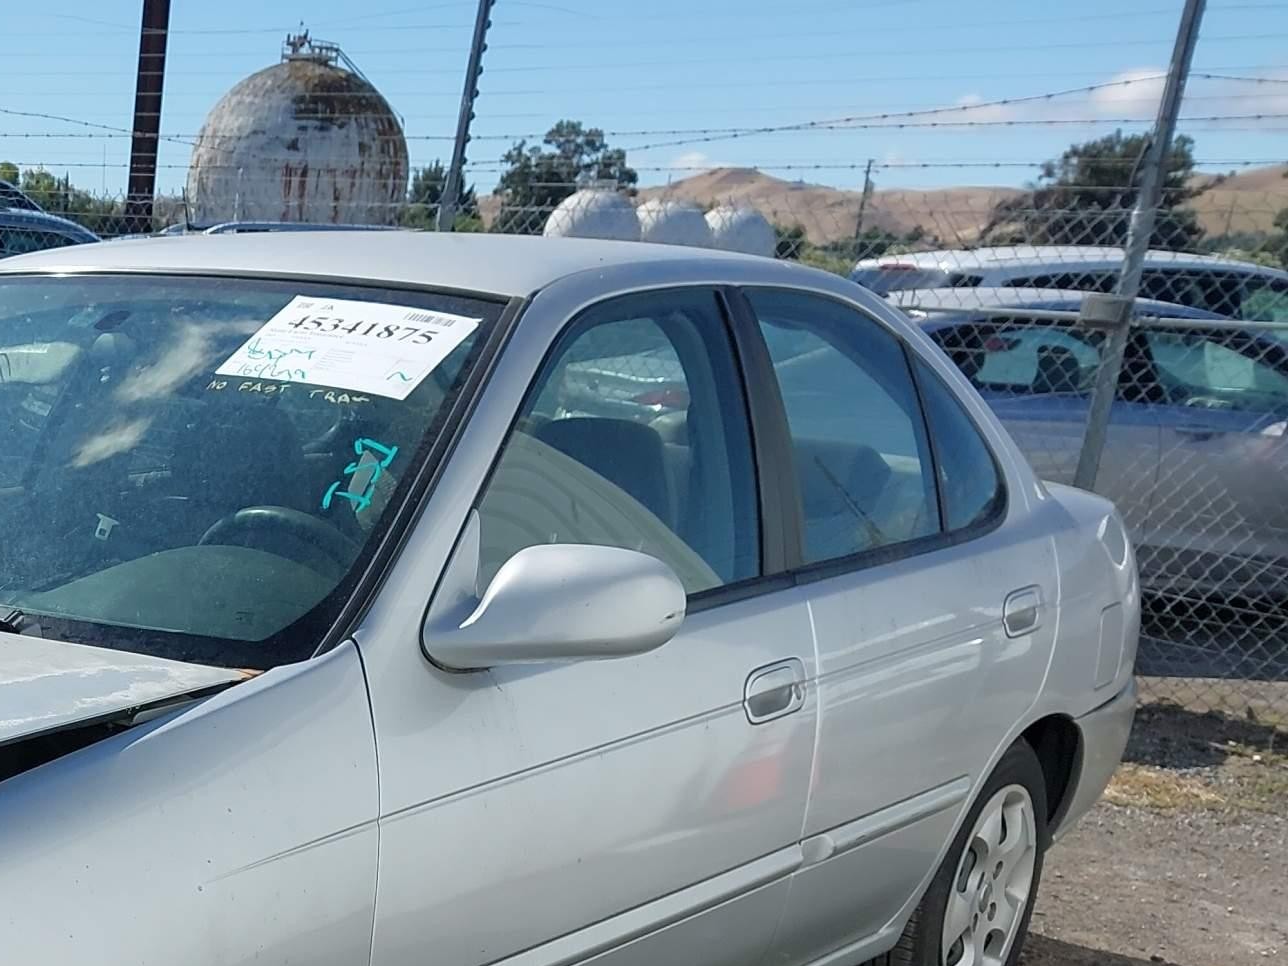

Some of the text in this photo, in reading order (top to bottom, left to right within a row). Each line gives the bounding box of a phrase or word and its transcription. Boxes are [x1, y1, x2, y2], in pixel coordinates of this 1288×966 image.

[288, 314, 439, 345] 45341875
[206, 380, 228, 391] NO
[238, 381, 292, 394] FAST
